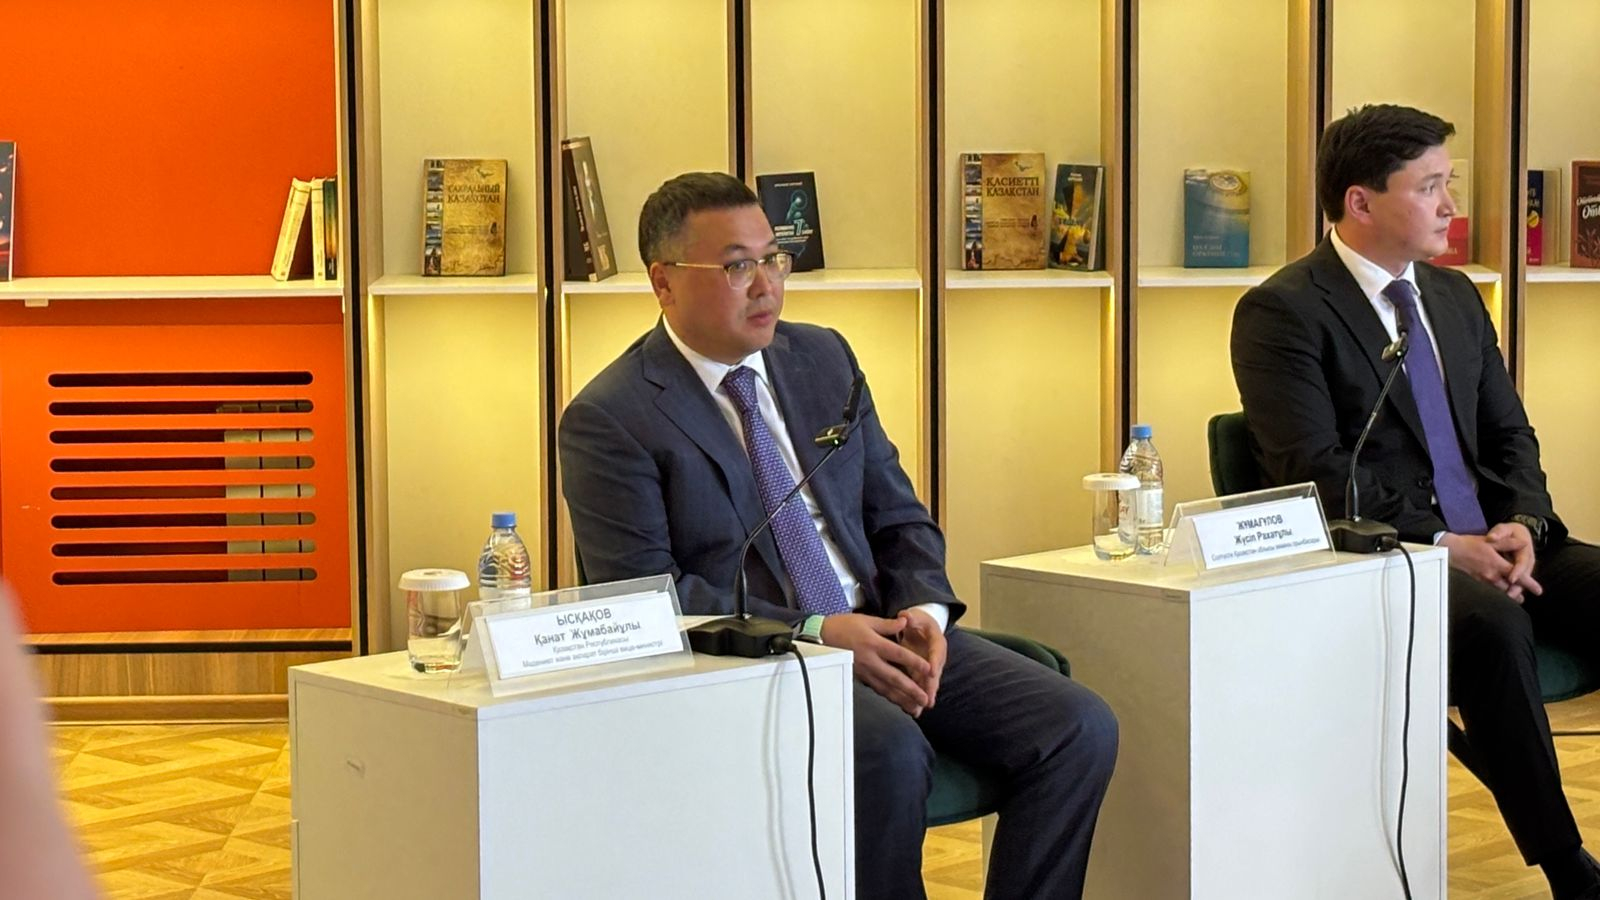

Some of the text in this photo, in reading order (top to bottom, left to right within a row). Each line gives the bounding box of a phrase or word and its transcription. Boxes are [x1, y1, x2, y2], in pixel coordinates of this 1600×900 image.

[556, 607, 612, 626] ЫСҚАҚОВ
[534, 621, 641, 646] Қанат Жұмабайұлы
